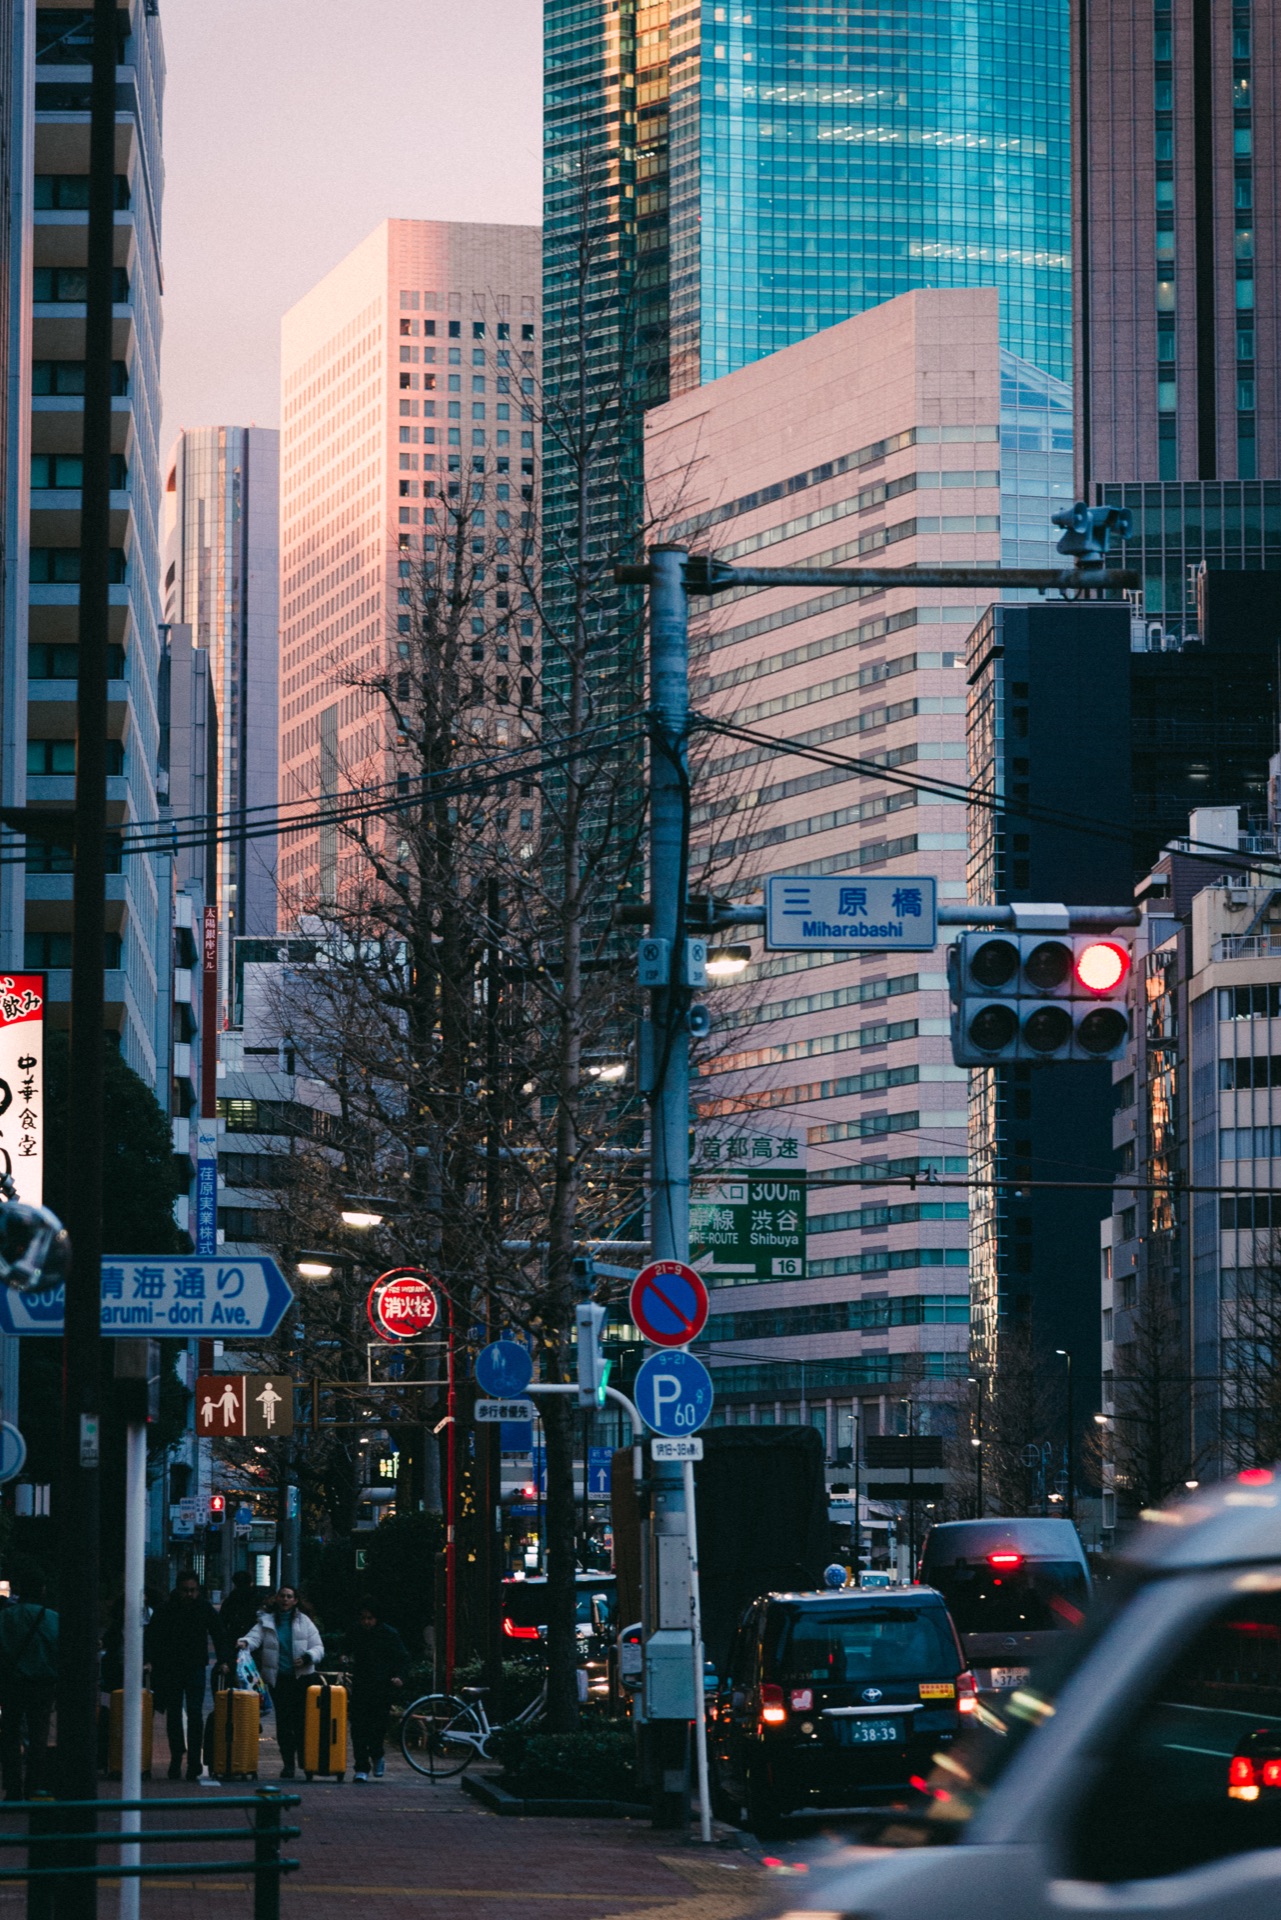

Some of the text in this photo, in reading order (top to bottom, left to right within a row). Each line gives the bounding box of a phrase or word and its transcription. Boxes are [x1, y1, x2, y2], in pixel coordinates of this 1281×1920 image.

[782, 887, 923, 918] 三原橋
[204, 907, 216, 970] 太陽銀座ビル
[802, 921, 903, 937] Miharabashi
[3, 991, 41, 1020] 飲み
[17, 1053, 39, 1157] 中華食堂
[702, 1136, 798, 1159] 首都高速
[751, 1183, 801, 1202] 300m
[199, 1166, 214, 1255] 荏原実業株式
[751, 1209, 798, 1232] 渋谷
[750, 1233, 799, 1247] Shibuya
[655, 1264, 682, 1276] 21-9
[777, 1260, 796, 1274] 16
[101, 1301, 251, 1325] arumi-dori Ave.
[384, 1296, 431, 1319] 消火栓
[659, 1354, 686, 1365] 9-21
[479, 1405, 529, 1418] 歩行者優先
[652, 1374, 696, 1427] P 60
[861, 1727, 896, 1741] 38-39
